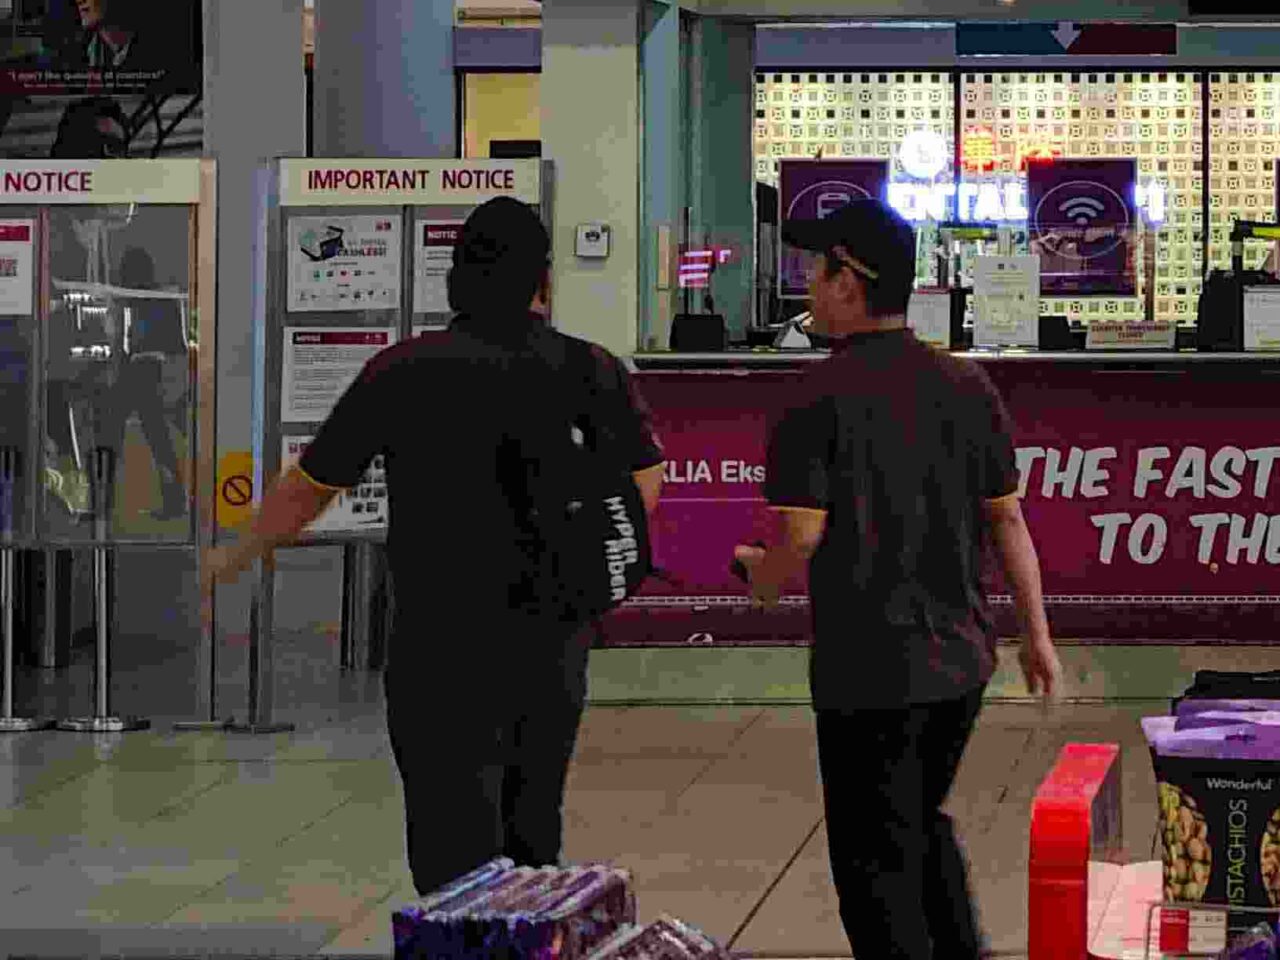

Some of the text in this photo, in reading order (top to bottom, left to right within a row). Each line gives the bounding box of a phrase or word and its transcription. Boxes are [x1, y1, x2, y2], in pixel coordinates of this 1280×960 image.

[5, 172, 93, 192] NOTICE
[308, 170, 515, 190] IMPORTANT NOTICE
[1014, 447, 1117, 498] THE
[1091, 513, 1168, 564] TO
[1206, 778, 1272, 790] Wonderful
